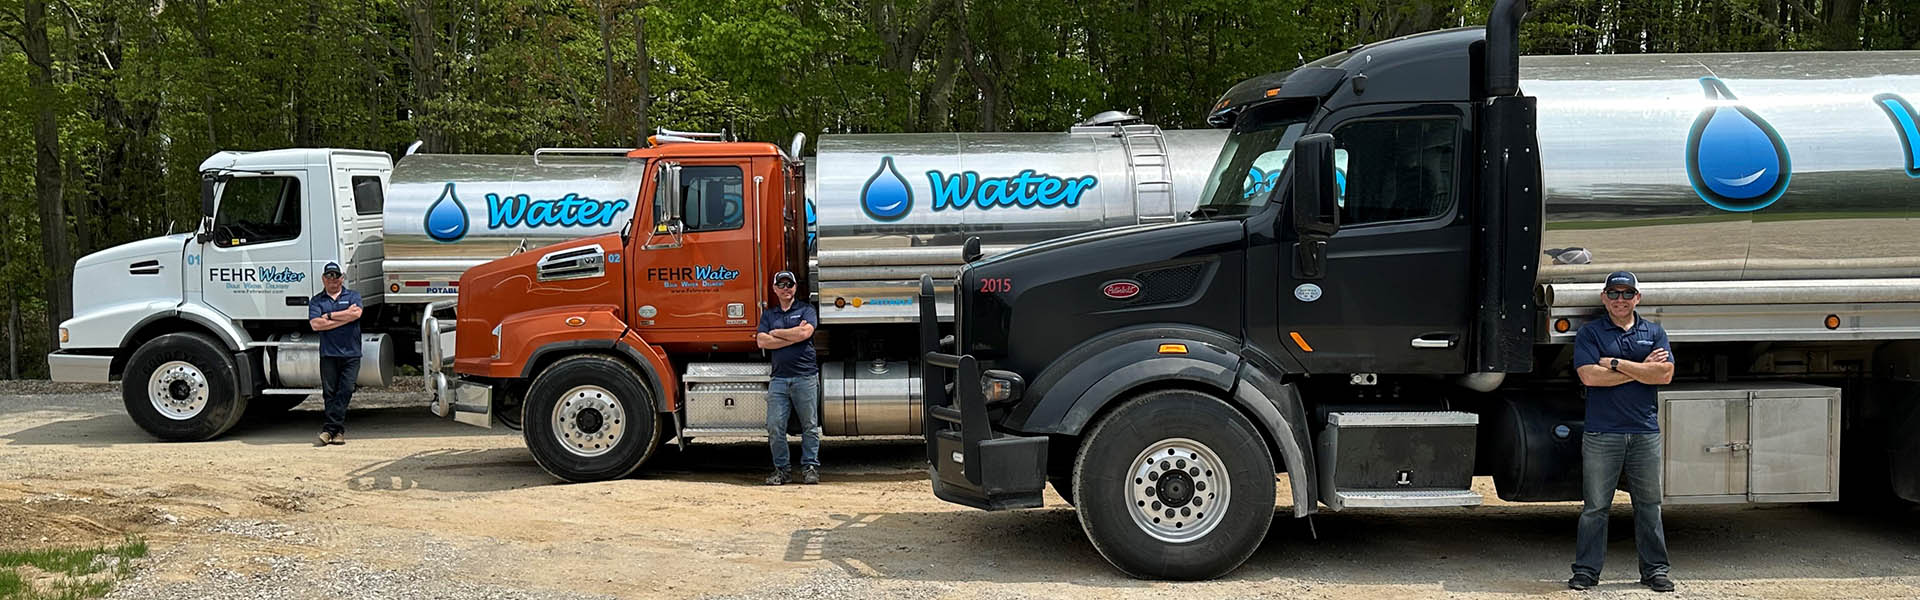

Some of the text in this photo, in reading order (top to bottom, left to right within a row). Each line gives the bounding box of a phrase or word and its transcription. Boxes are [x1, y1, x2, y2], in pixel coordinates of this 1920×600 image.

[926, 169, 1098, 211] Water
[485, 193, 629, 229] Water
[187, 254, 201, 266] 01
[608, 253, 620, 263] 02
[209, 266, 305, 282] FEHR Water
[648, 264, 739, 280] FEHR Water
[980, 278, 1012, 293] 2015
